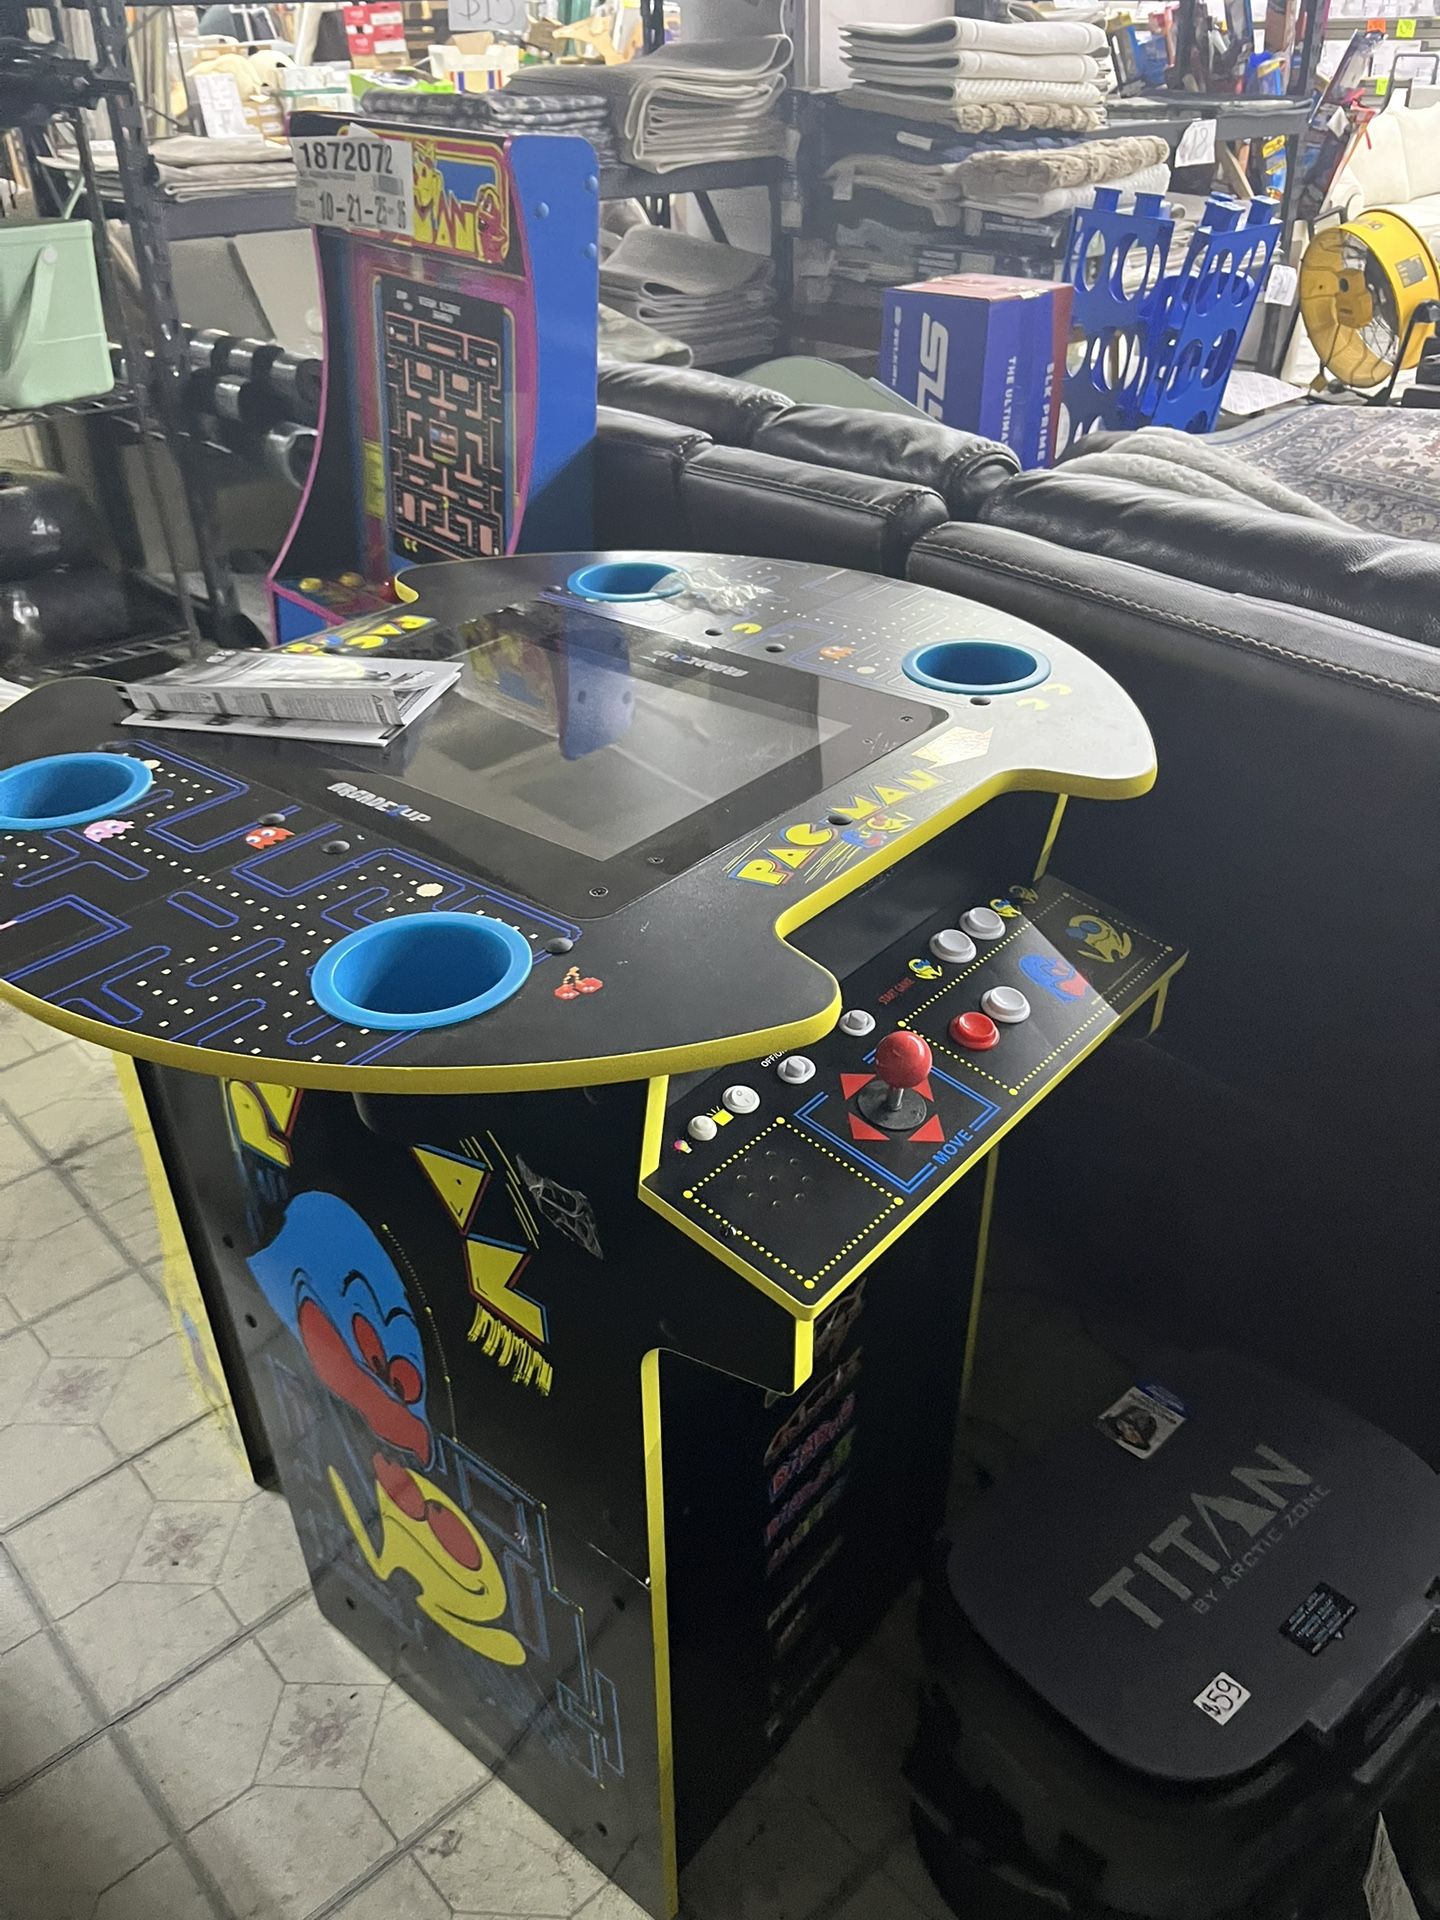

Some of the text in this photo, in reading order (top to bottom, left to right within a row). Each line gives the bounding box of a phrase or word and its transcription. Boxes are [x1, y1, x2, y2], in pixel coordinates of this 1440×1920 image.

[299, 142, 393, 174] 1872072
[1006, 356, 1017, 385] THE
[1037, 363, 1055, 461] SLK PRIME
[729, 769, 944, 887] PACMAN
[932, 1129, 974, 1165] MOVE
[1088, 1443, 1313, 1630] TITAN
[1192, 1484, 1331, 1616] BY ARCTIC ZONE
[1200, 1677, 1243, 1719] $59
